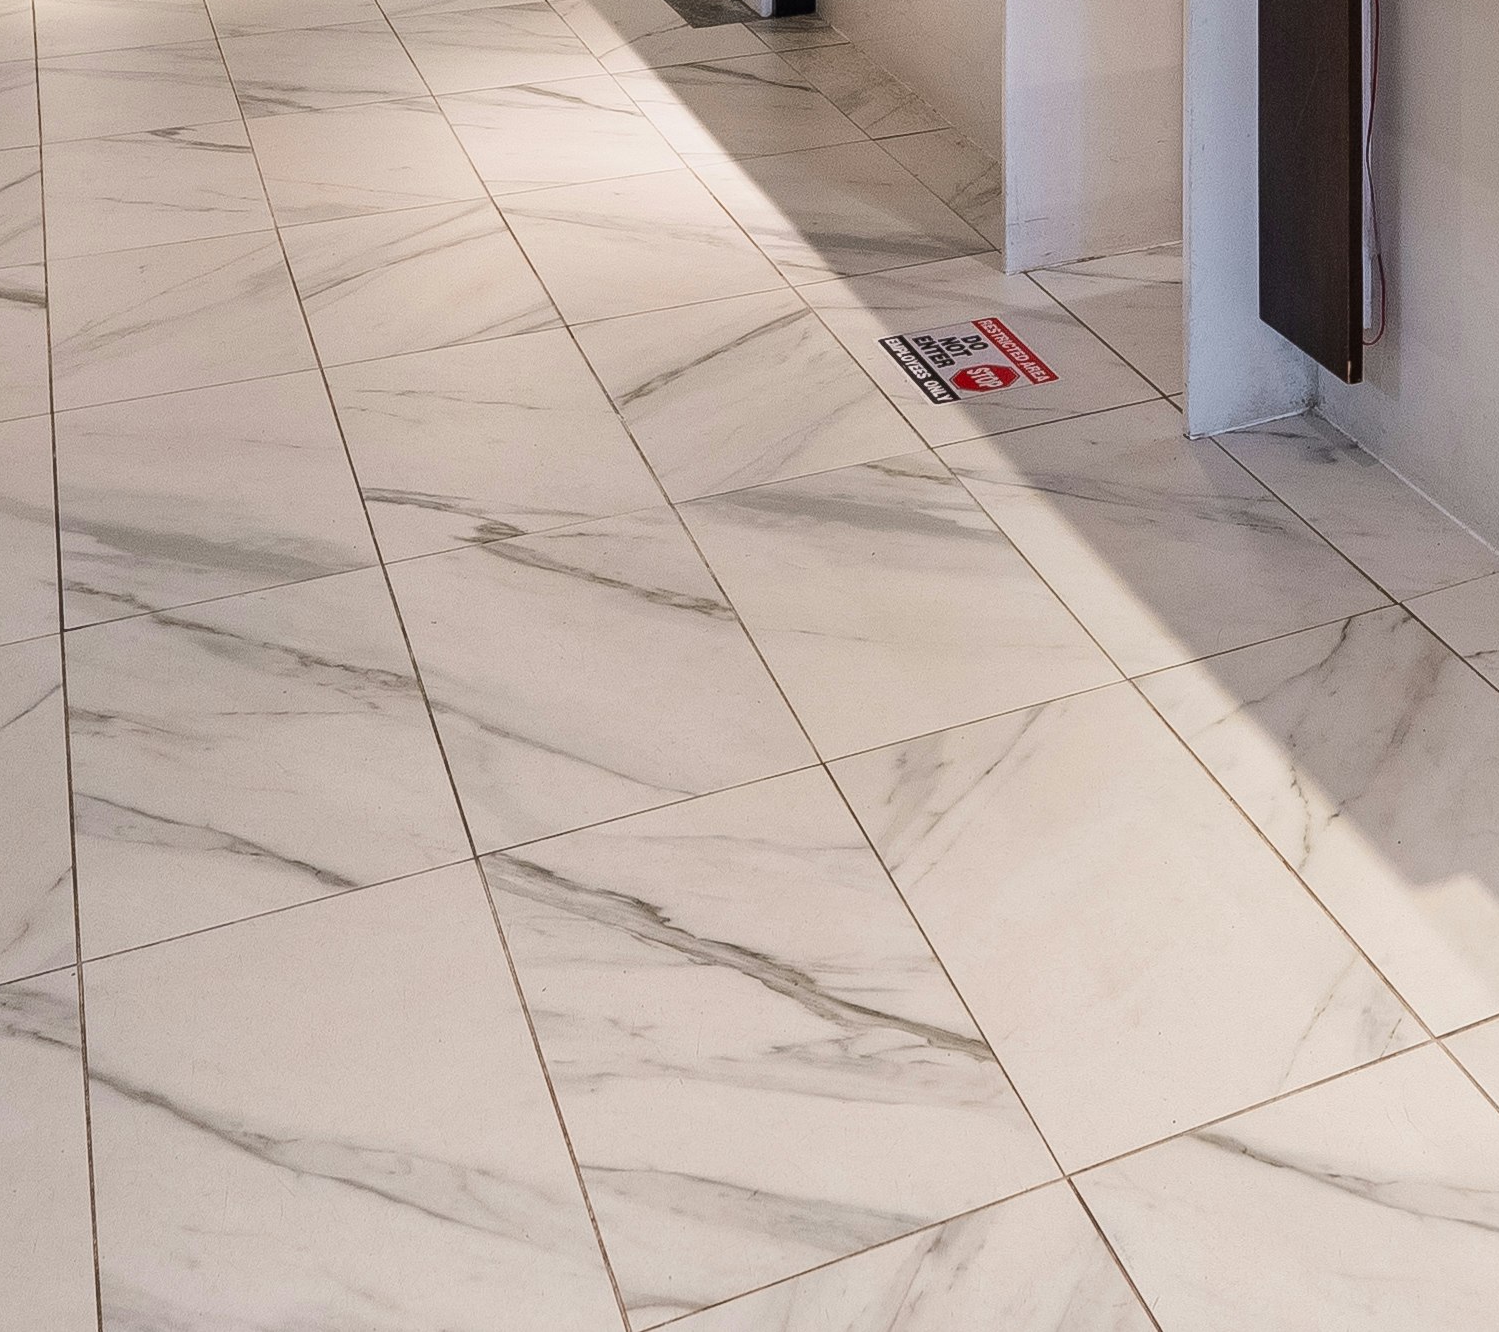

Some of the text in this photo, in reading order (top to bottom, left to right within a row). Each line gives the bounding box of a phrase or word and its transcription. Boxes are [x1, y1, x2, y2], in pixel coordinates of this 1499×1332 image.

[912, 335, 956, 369] ENTER
[937, 336, 973, 358] NOT
[960, 335, 990, 351] DO
[978, 319, 1050, 382] RESTRICTED AREA
[884, 337, 954, 402] EMPLOYEES ONLY
[966, 366, 1004, 388] STOP
